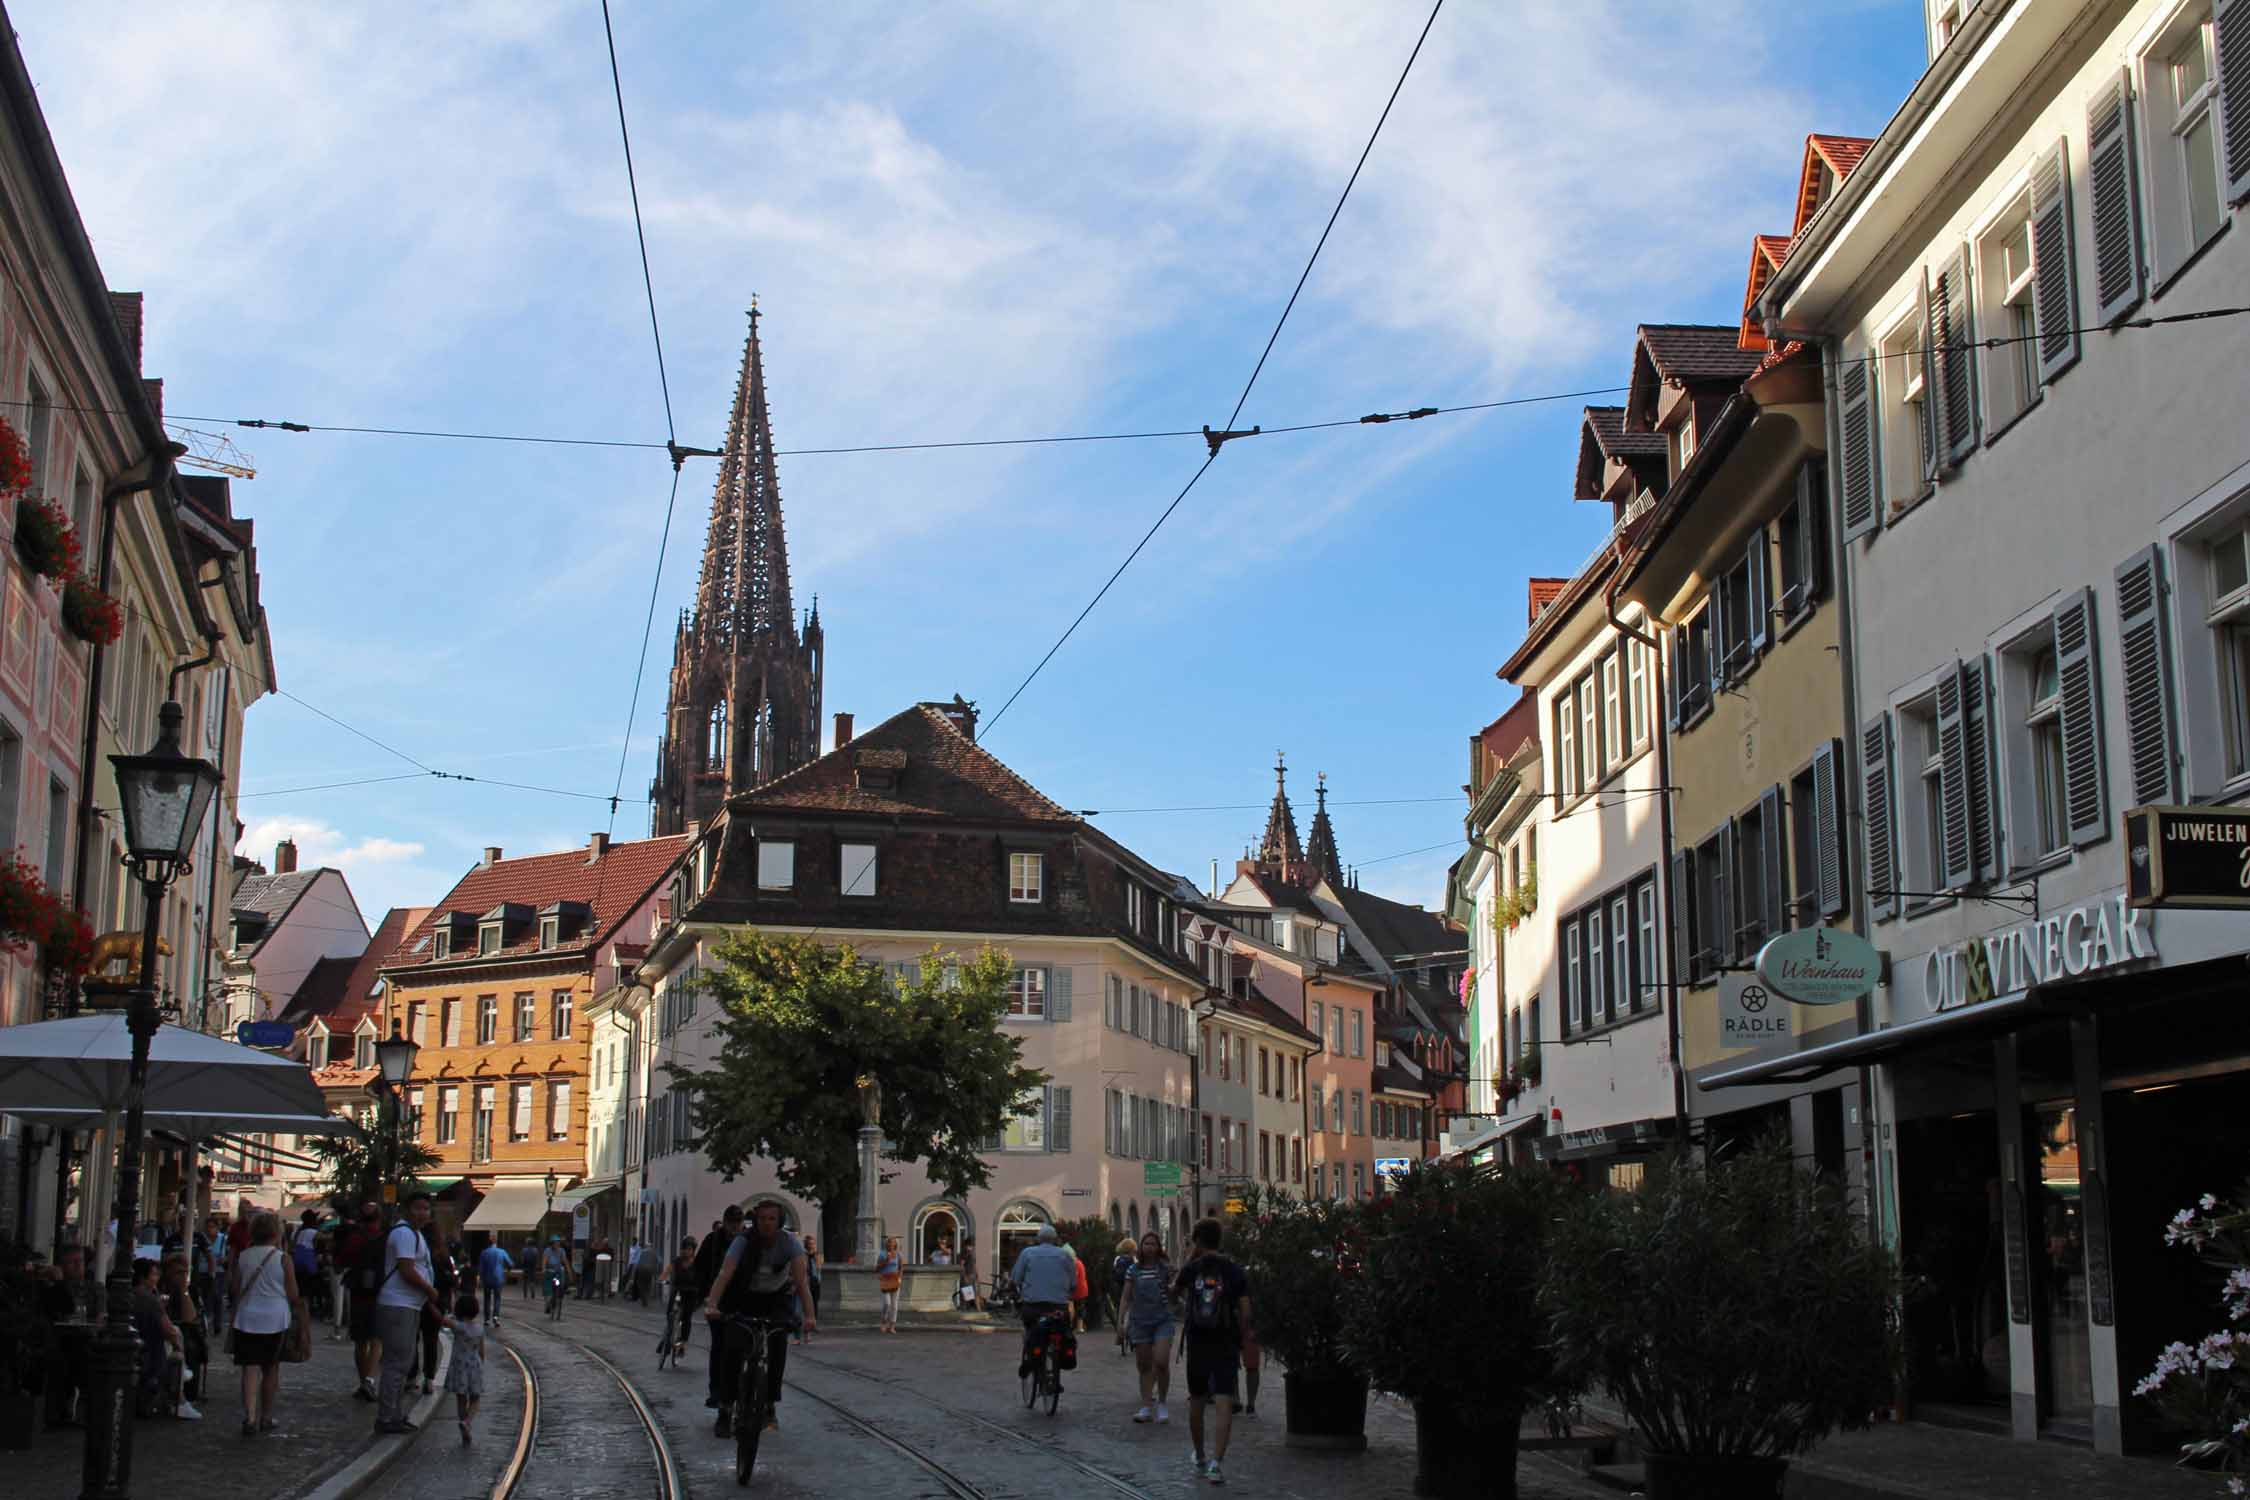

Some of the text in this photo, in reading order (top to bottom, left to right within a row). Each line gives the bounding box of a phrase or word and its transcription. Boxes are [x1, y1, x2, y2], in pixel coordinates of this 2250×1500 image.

[2167, 822, 2247, 842] JUWELEN
[1781, 959, 1866, 979] Weinhaus
[1725, 1015, 1785, 1032] RÄDLE
